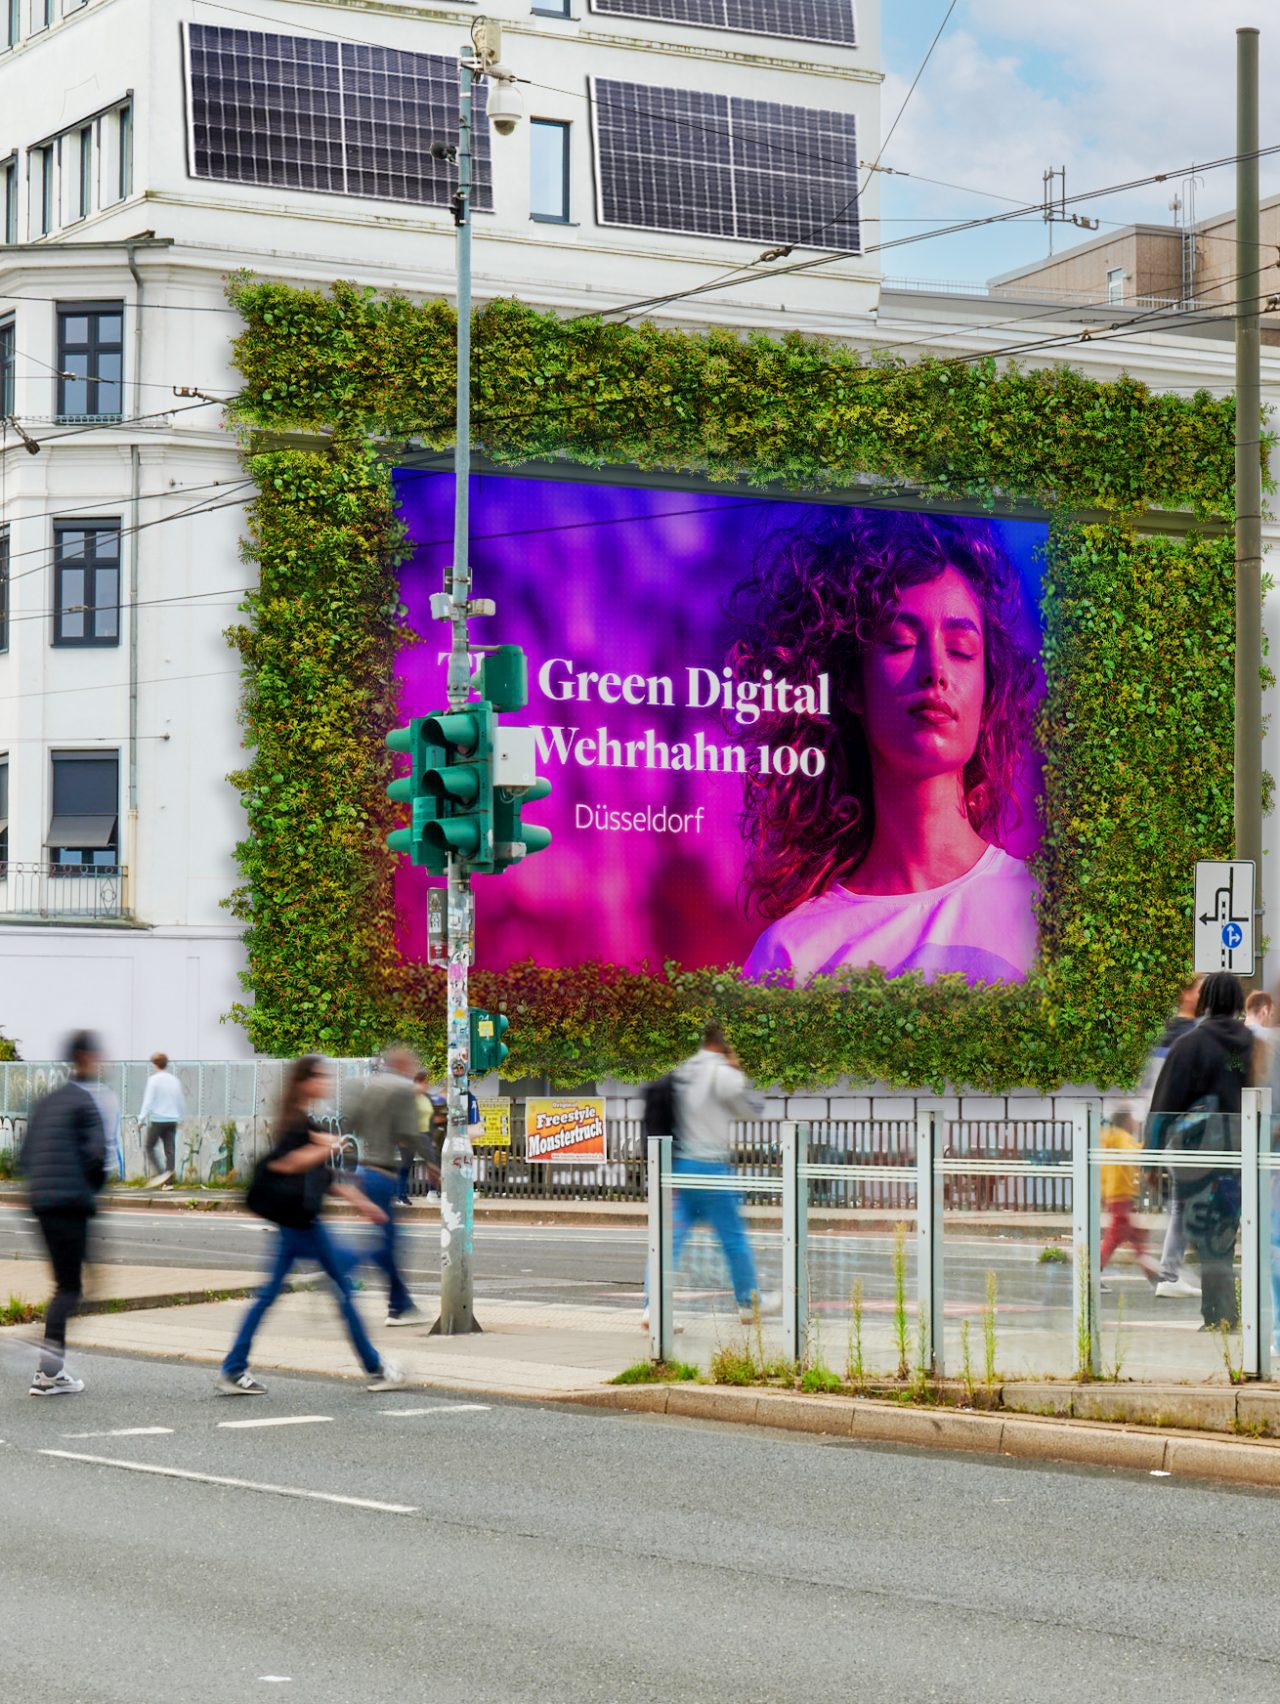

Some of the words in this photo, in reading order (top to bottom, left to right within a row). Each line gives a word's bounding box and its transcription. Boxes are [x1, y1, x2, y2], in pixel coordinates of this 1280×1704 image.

[538, 657, 674, 706] Green
[685, 666, 831, 724] Digital
[529, 724, 748, 774] Wehrhahn
[756, 744, 826, 778] 100
[575, 802, 705, 834] Düsseldorf
[528, 1117, 604, 1157] Monstertruck
[536, 1105, 596, 1130] Freestyle
